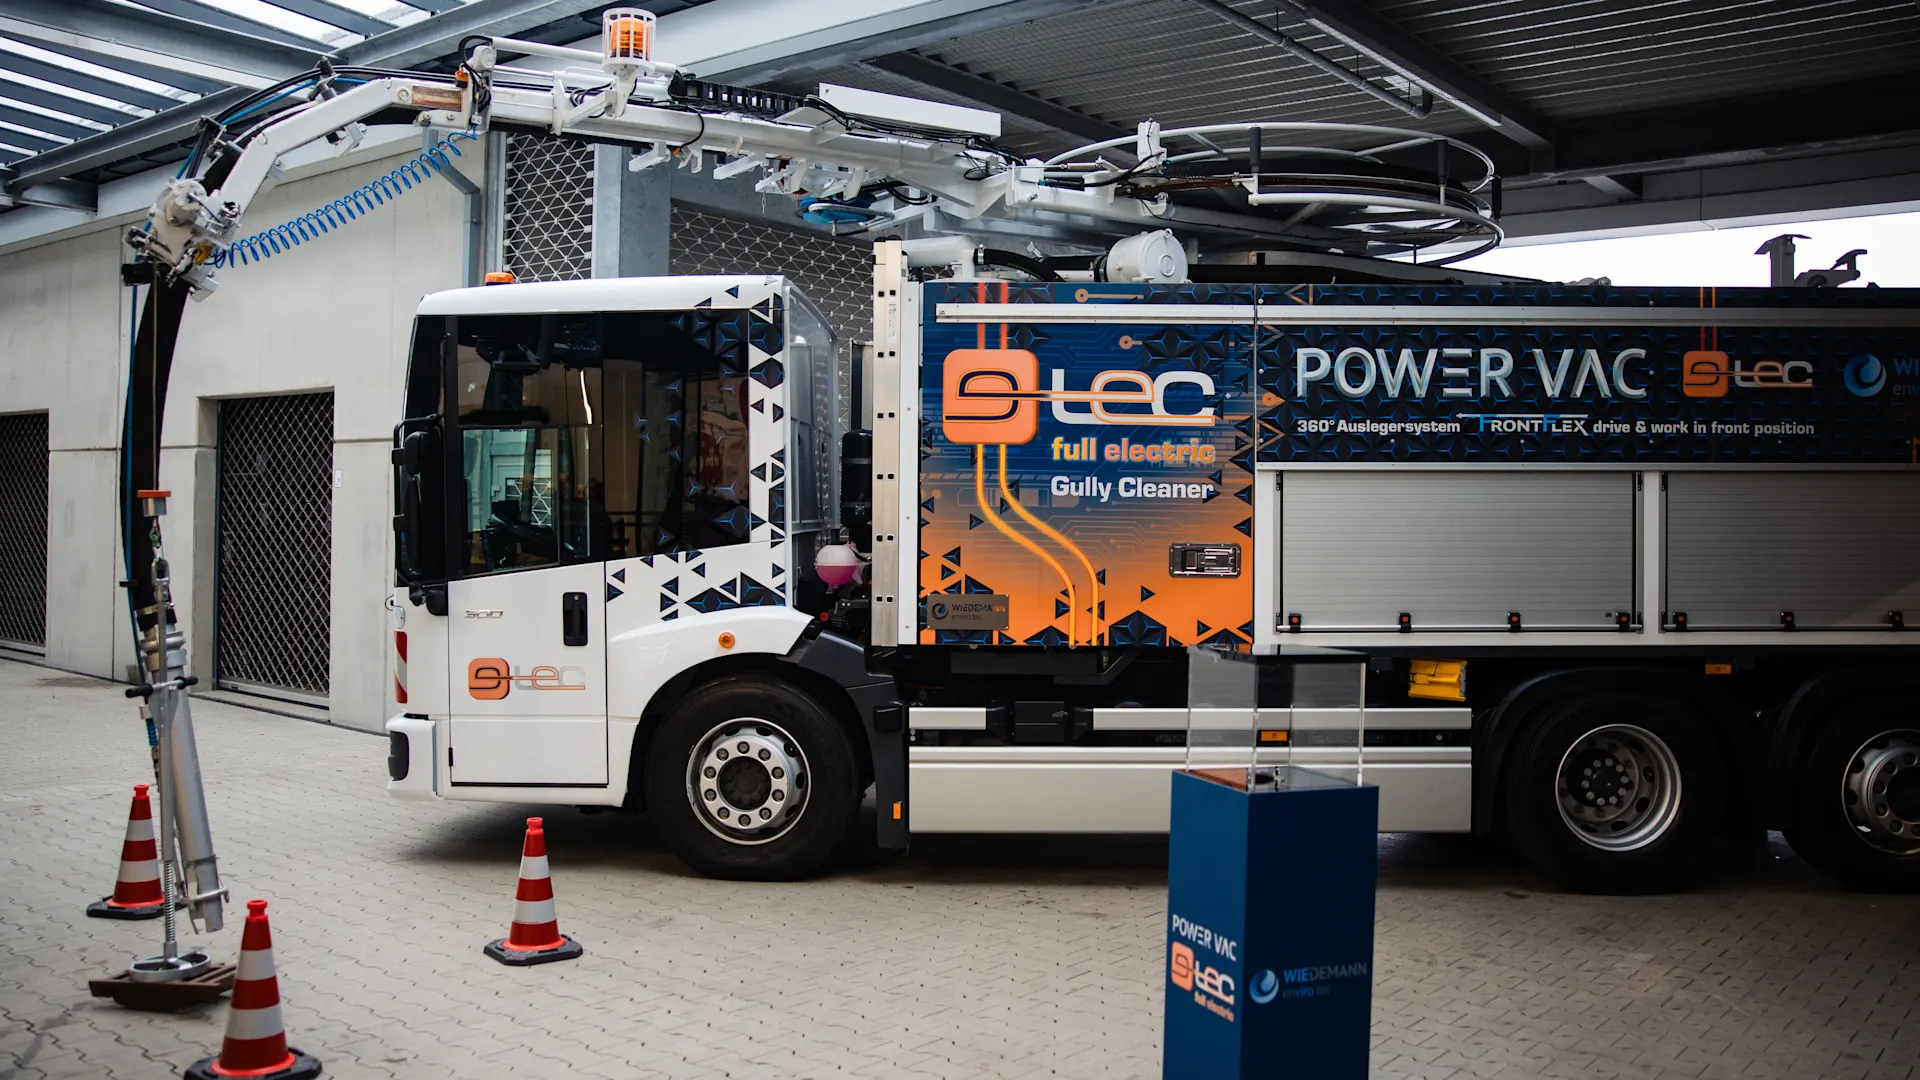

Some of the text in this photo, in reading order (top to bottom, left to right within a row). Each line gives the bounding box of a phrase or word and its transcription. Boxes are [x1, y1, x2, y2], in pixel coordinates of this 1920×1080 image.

[1296, 347, 1648, 399] POWER VAC
[1297, 414, 1815, 438] 360° Auslegersystem FRONTFLEX drive & work in front position
[1051, 437, 1216, 463] full electric
[1051, 475, 1214, 503] Gully Cleaner
[1172, 914, 1237, 962] POWER VAC
[1284, 963, 1367, 984] WIEDEMANN
